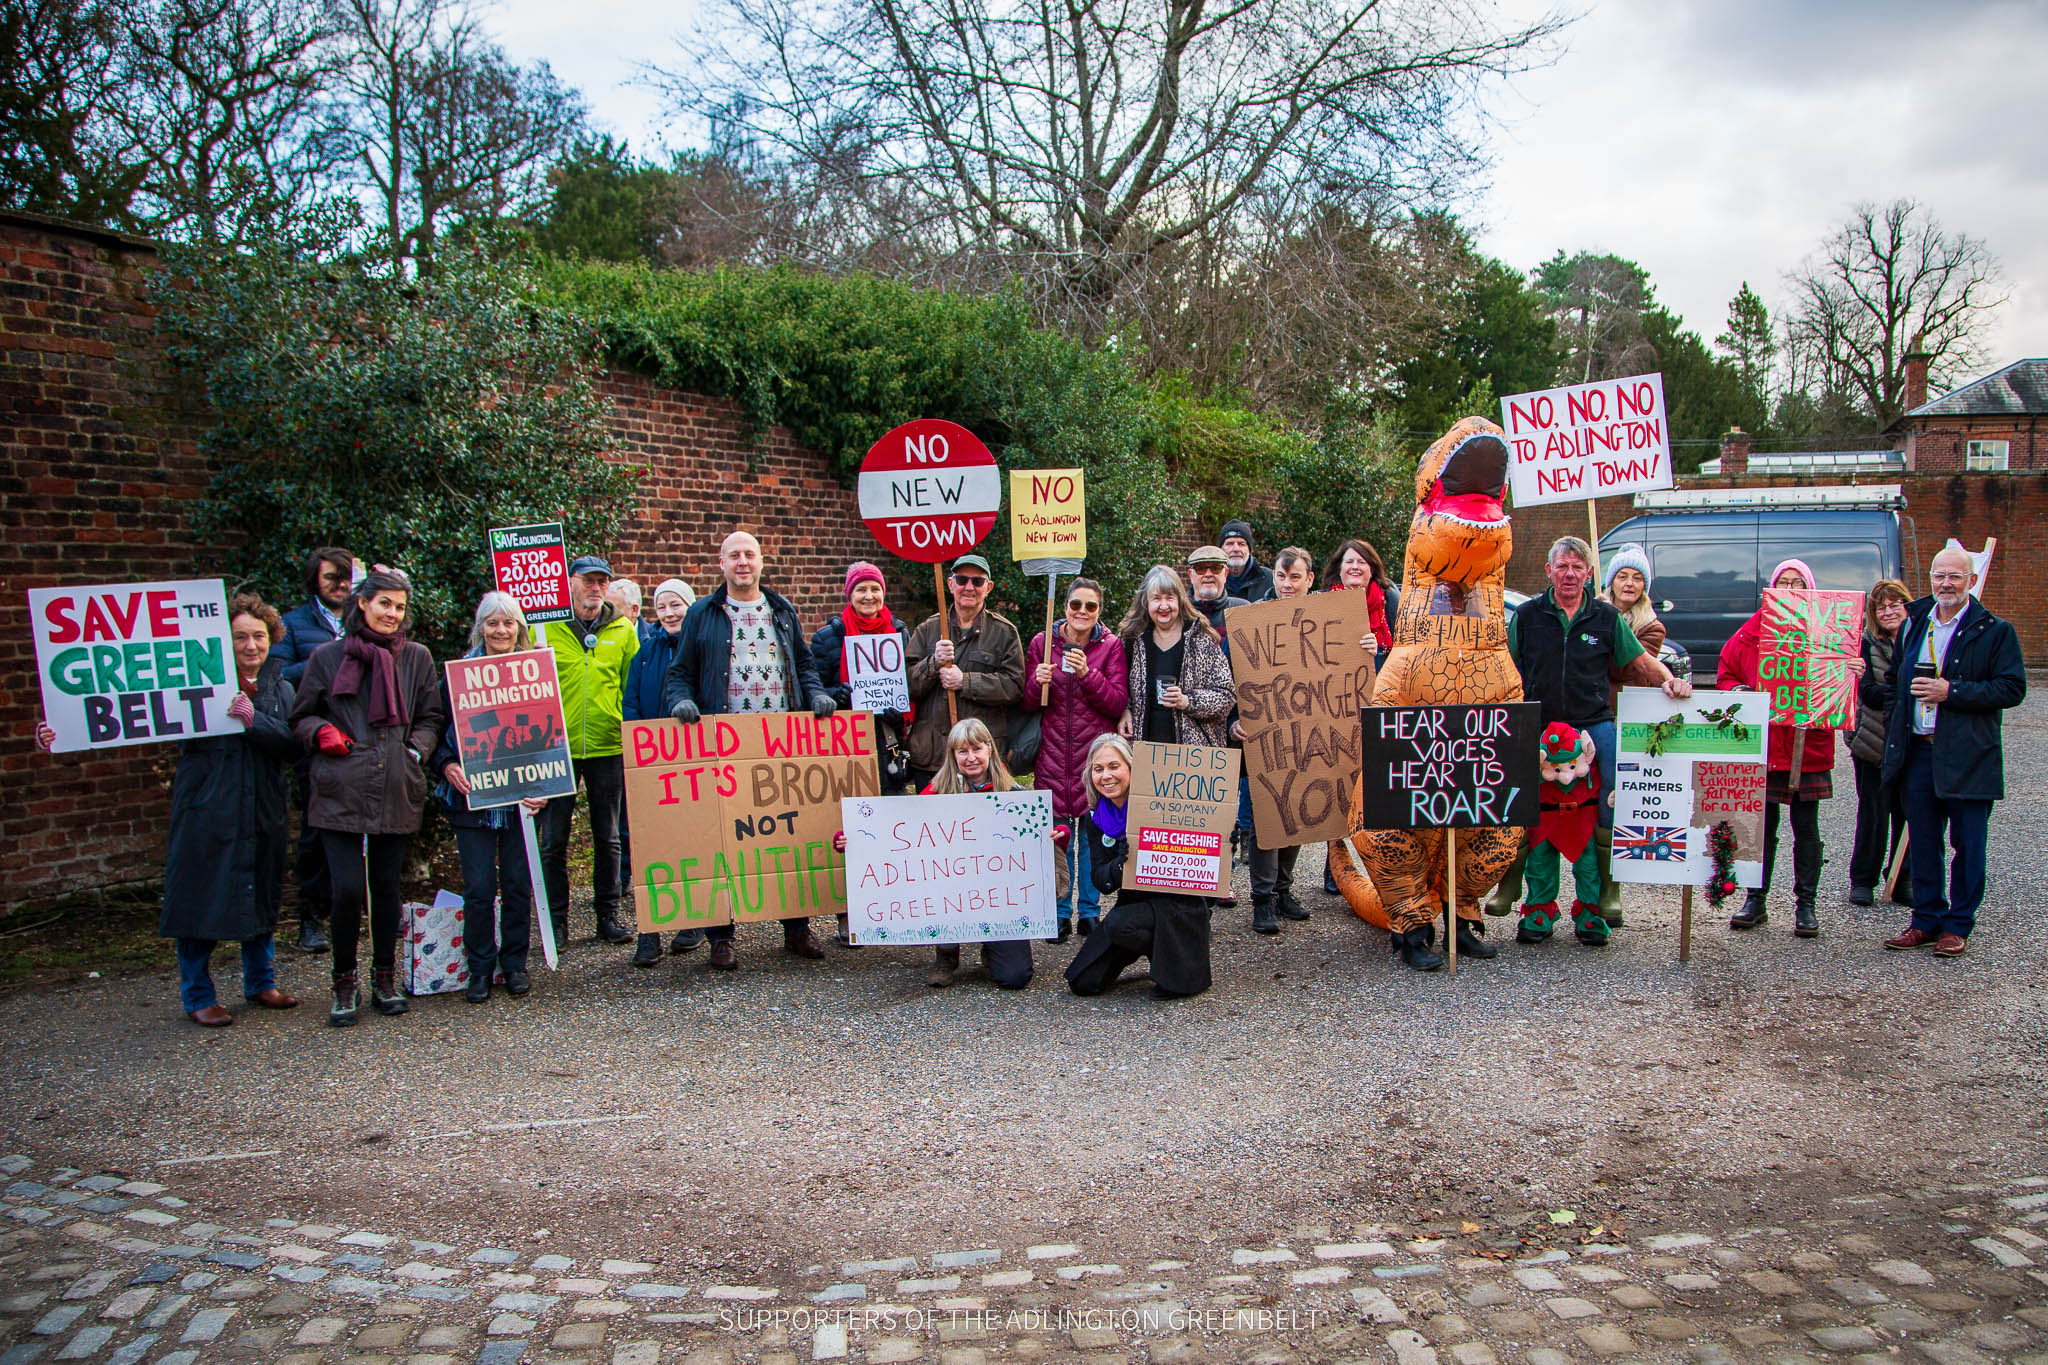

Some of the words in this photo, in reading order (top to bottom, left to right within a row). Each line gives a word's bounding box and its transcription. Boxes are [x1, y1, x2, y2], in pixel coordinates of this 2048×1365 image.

[1510, 396, 1559, 434] NO,
[1567, 389, 1610, 426] NO,
[1616, 382, 1655, 420] NO
[904, 433, 949, 464] NO
[1511, 438, 1536, 464] TO
[1544, 418, 1661, 461] ADLINGTON
[1537, 465, 1584, 495] NEW
[1592, 454, 1660, 487] TOWN!
[891, 475, 965, 508] NEW
[1032, 474, 1074, 506] NO
[886, 519, 976, 548] TOWN
[1025, 531, 1048, 543] NEW
[500, 561, 562, 583] 20,000
[510, 550, 549, 566] STOP
[508, 579, 560, 596] HOUSE
[45, 590, 181, 643] SAVE
[182, 602, 219, 618] THE
[526, 609, 570, 621] GREENBELT
[1773, 597, 1854, 629] SAVE
[1231, 608, 1345, 670] WE'RE
[1773, 629, 1846, 655] YOUR
[49, 637, 226, 695] GREEN
[853, 638, 902, 674] NO
[1759, 655, 1847, 682] GREEN
[463, 663, 500, 690] NO
[506, 658, 540, 683] TO
[853, 677, 903, 690] ADLINGTON
[458, 680, 554, 710] ADLINGTON
[860, 697, 894, 709] TOWN
[864, 688, 894, 698] NEW
[1238, 664, 1371, 723] STRONGER
[83, 687, 215, 742] BELT
[1380, 708, 1450, 740] HEAR
[1464, 708, 1512, 737] OUR
[632, 721, 740, 767] BUILD
[761, 713, 871, 758] WHERE
[1248, 721, 1362, 773] THAN
[1622, 727, 1652, 738] SAVE
[1145, 743, 1203, 768] THIS
[1210, 749, 1227, 770] IS
[1411, 738, 1496, 762] VOICES
[469, 768, 509, 791] NEW
[513, 759, 567, 784] TOWN
[658, 764, 738, 805] IT'S
[751, 758, 881, 807] BROWN
[1388, 760, 1457, 790] HEAR
[1472, 761, 1505, 787] US
[1643, 768, 1663, 778] NO
[1696, 761, 1763, 776] Starmer
[1698, 775, 1740, 788] taking
[1741, 775, 1766, 789] the
[1151, 771, 1228, 802] WRONG
[1622, 781, 1683, 792] FARMERS
[1642, 796, 1661, 806] NO
[1703, 786, 1757, 800] farmer
[1149, 800, 1165, 812] ON
[1168, 803, 1181, 813] SO
[1183, 804, 1218, 816] MANY
[1410, 786, 1520, 826] ROAR!
[1632, 810, 1670, 820] FOOD
[1721, 801, 1732, 812] a
[1734, 799, 1764, 813] ride
[734, 811, 798, 841] NOT
[890, 816, 977, 852] SAVE
[1162, 814, 1207, 828] LEVELS
[1142, 830, 1169, 845] SAVE
[1169, 832, 1219, 848] CHESHIRE
[1152, 844, 1169, 852] SAVE
[1169, 845, 1208, 854] ADLINGTON
[860, 851, 1026, 888] ADLINGTON
[1141, 865, 1179, 877] HOUSE
[1181, 868, 1215, 880] TOWN
[1151, 853, 1168, 864] NO
[1170, 855, 1207, 867] 20,000
[644, 840, 847, 925] BEAUTIFU
[1152, 879, 1180, 888] SERVICES
[1180, 881, 1200, 889] CAN'T
[1200, 883, 1217, 891] COPE
[866, 883, 1036, 922] GREENBELT
